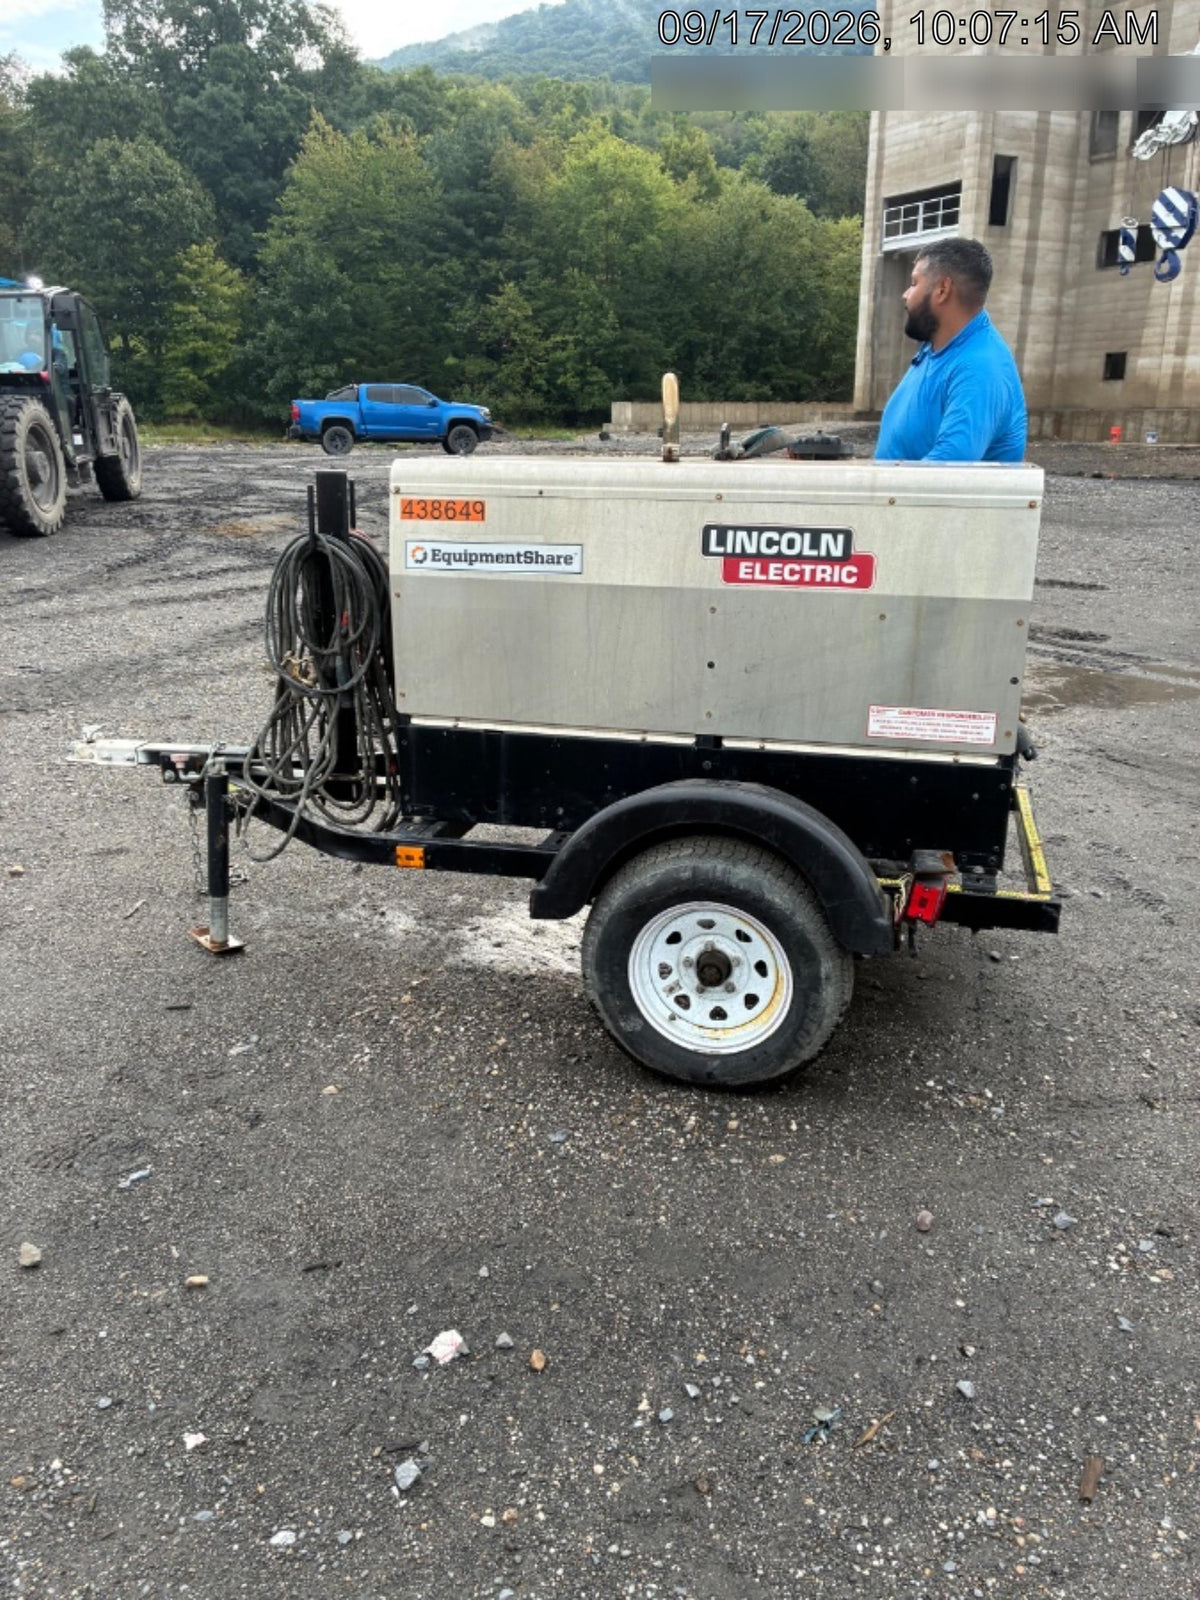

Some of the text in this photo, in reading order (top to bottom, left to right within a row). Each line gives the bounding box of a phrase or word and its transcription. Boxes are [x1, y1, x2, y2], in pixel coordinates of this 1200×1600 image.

[401, 499, 485, 520] 438649
[708, 528, 845, 558] LINCOLN
[430, 548, 574, 566] EquipmentShare
[738, 561, 858, 584] ELECTRIC
